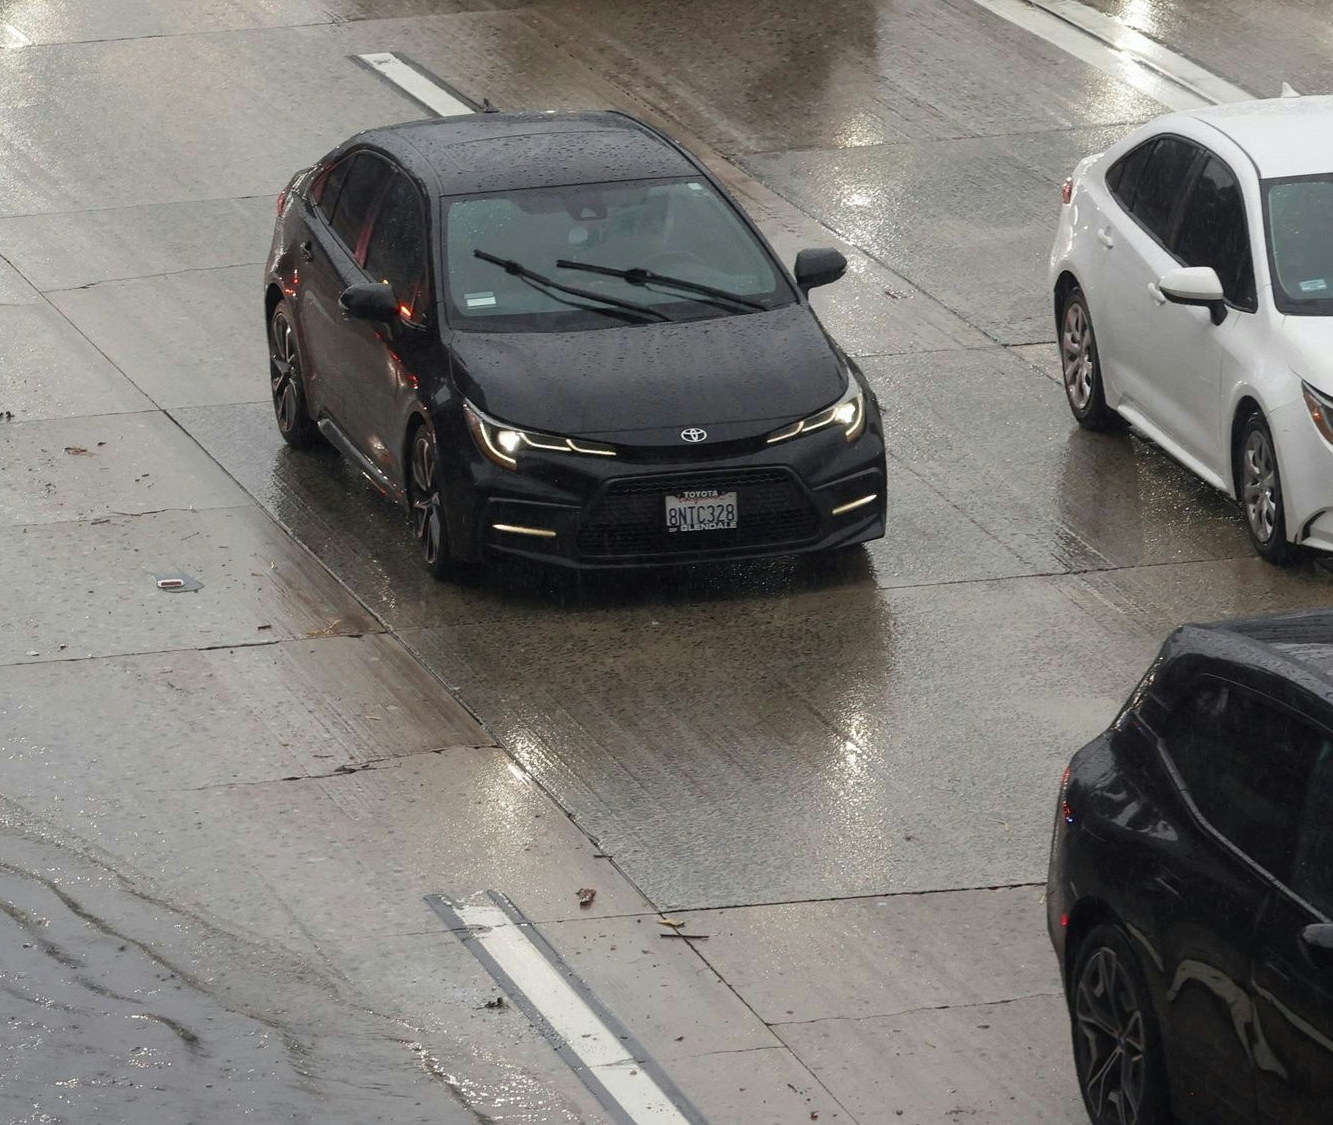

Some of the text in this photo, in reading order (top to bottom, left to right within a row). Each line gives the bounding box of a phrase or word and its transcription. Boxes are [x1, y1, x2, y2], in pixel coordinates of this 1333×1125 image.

[683, 490, 718, 498] TOYOTA
[669, 503, 735, 526] 8NTC328
[680, 521, 737, 532] GLENDALE
